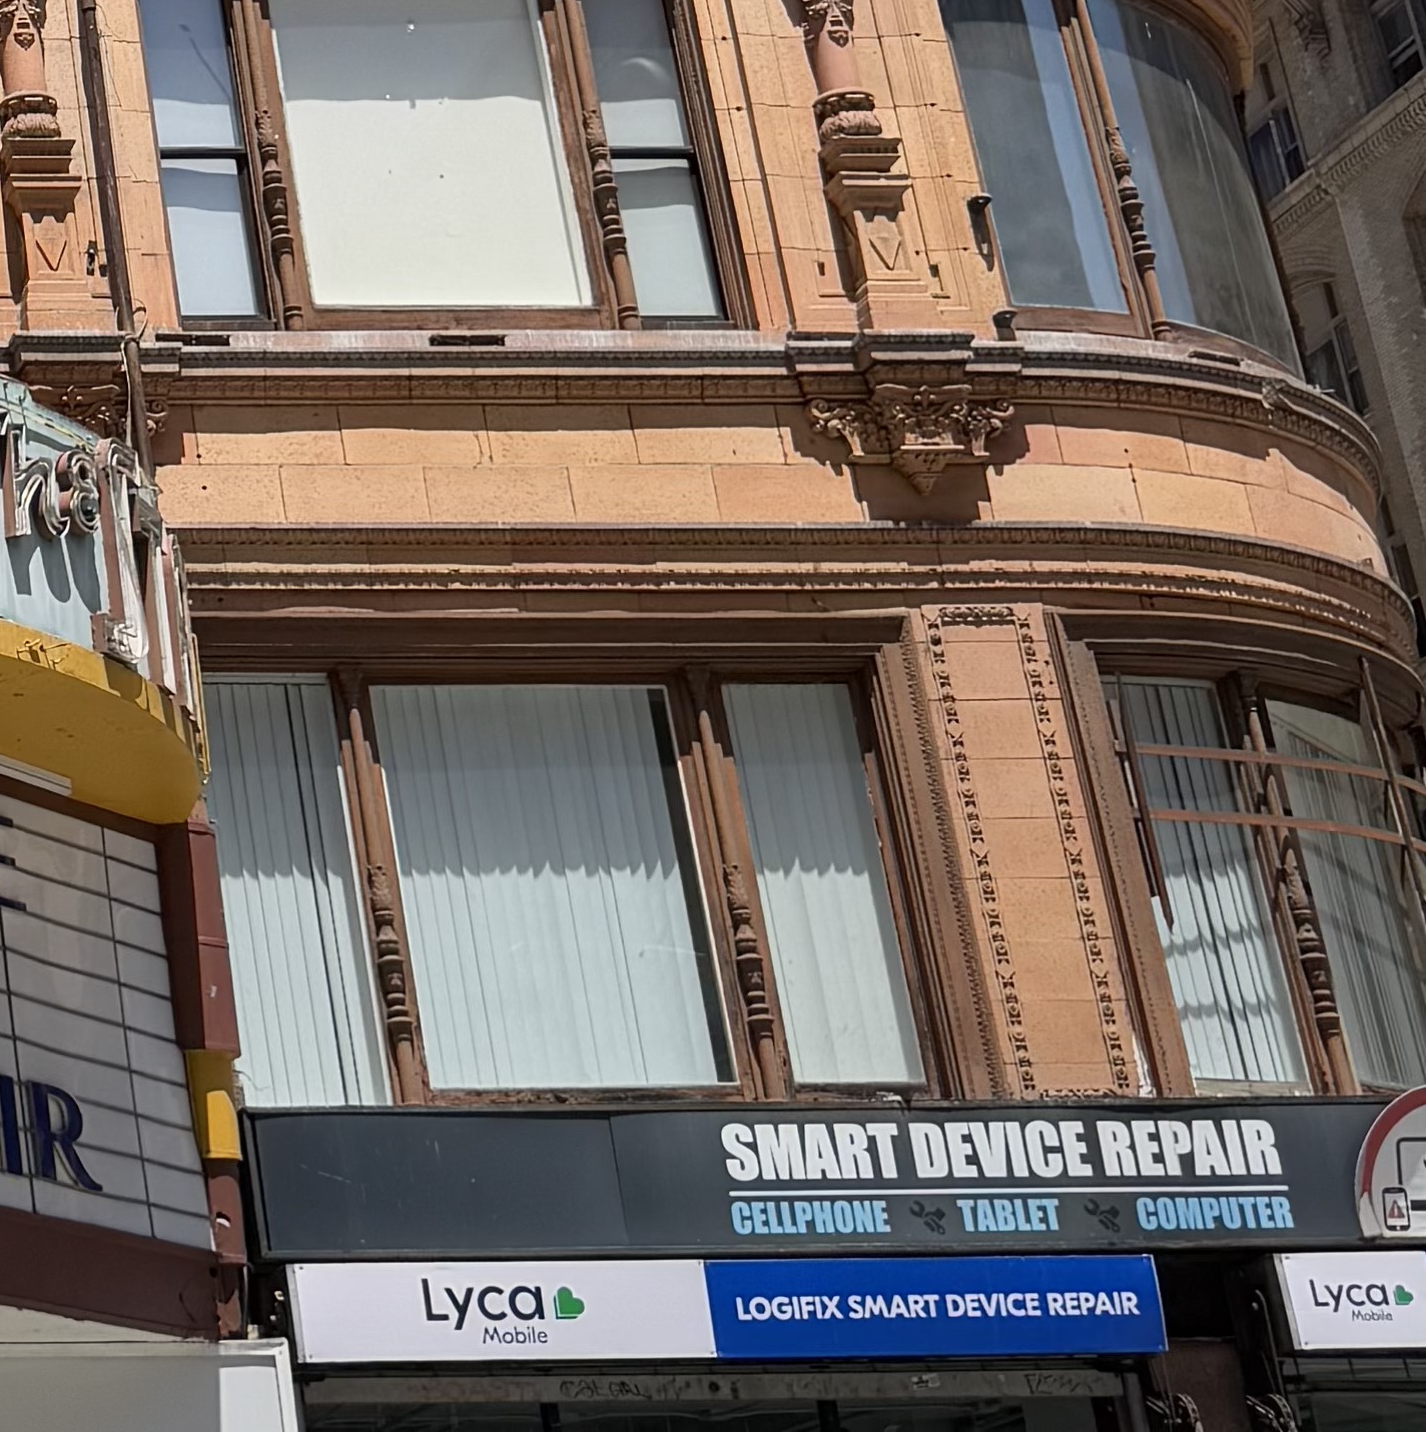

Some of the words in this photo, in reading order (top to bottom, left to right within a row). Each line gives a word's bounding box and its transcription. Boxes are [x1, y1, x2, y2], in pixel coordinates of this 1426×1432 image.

[720, 1122, 899, 1182] SMART
[908, 1120, 1093, 1179] DEVICE
[1095, 1119, 1284, 1177] REPAIR
[729, 1200, 891, 1235] CELLPHONE
[956, 1198, 1061, 1232] TABLET
[1134, 1196, 1295, 1230] COMPUTER
[421, 1278, 546, 1331] Lyca
[735, 1294, 845, 1322] LOGIFIX
[848, 1293, 940, 1320] SMART
[946, 1292, 1041, 1318] DEVICE
[1047, 1290, 1141, 1316] REPAIR
[1308, 1278, 1391, 1313] Lyca
[482, 1326, 548, 1344] Mobile
